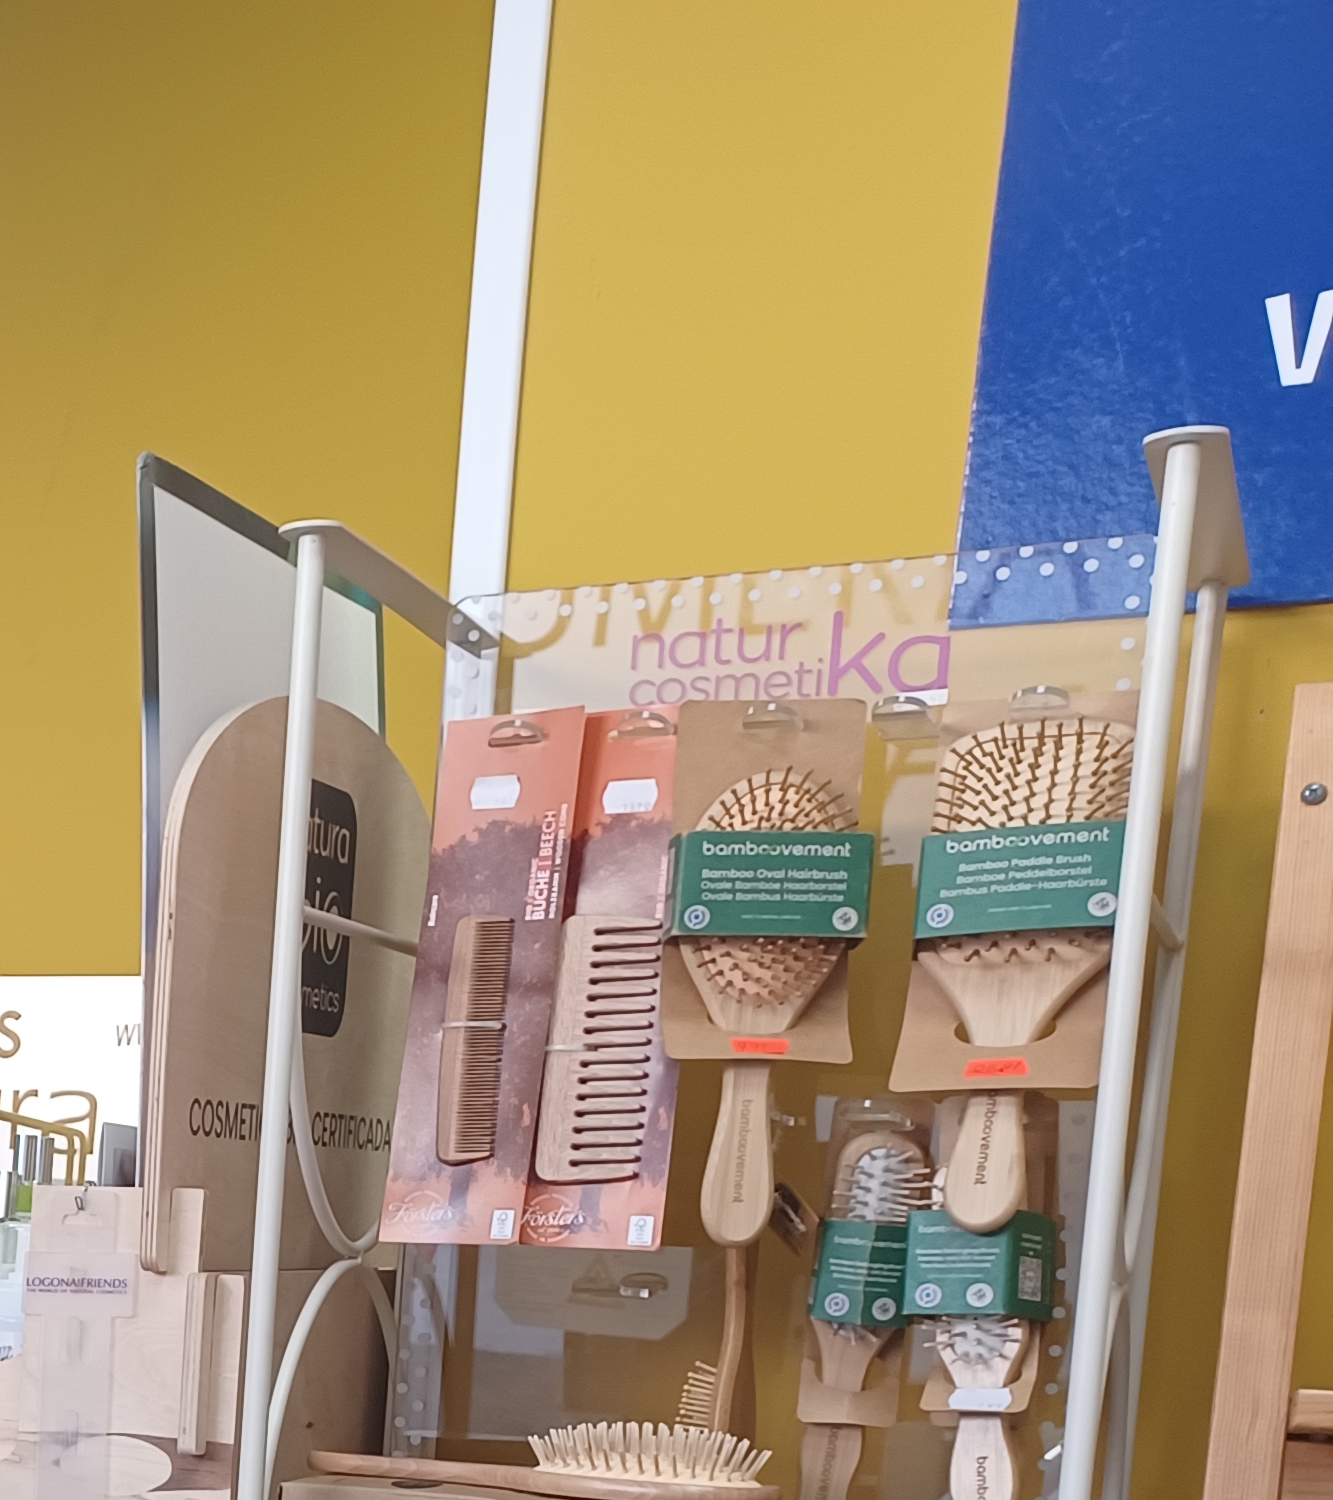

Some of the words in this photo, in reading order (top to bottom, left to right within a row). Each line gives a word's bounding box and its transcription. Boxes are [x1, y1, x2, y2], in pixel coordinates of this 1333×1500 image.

[631, 619, 804, 671] natur
[539, 811, 557, 857] BEECH
[702, 841, 851, 858] bamboovement
[945, 828, 1110, 854] bamboovement
[701, 869, 754, 879] Bamboo
[757, 869, 785, 879] Oval
[787, 869, 848, 880] Hairbrush
[958, 860, 1009, 873] Bamboo
[1012, 856, 1053, 869] Paddle
[1056, 853, 1092, 864] Brush
[532, 869, 550, 921] BUCHE
[733, 1099, 754, 1204] bamboovement
